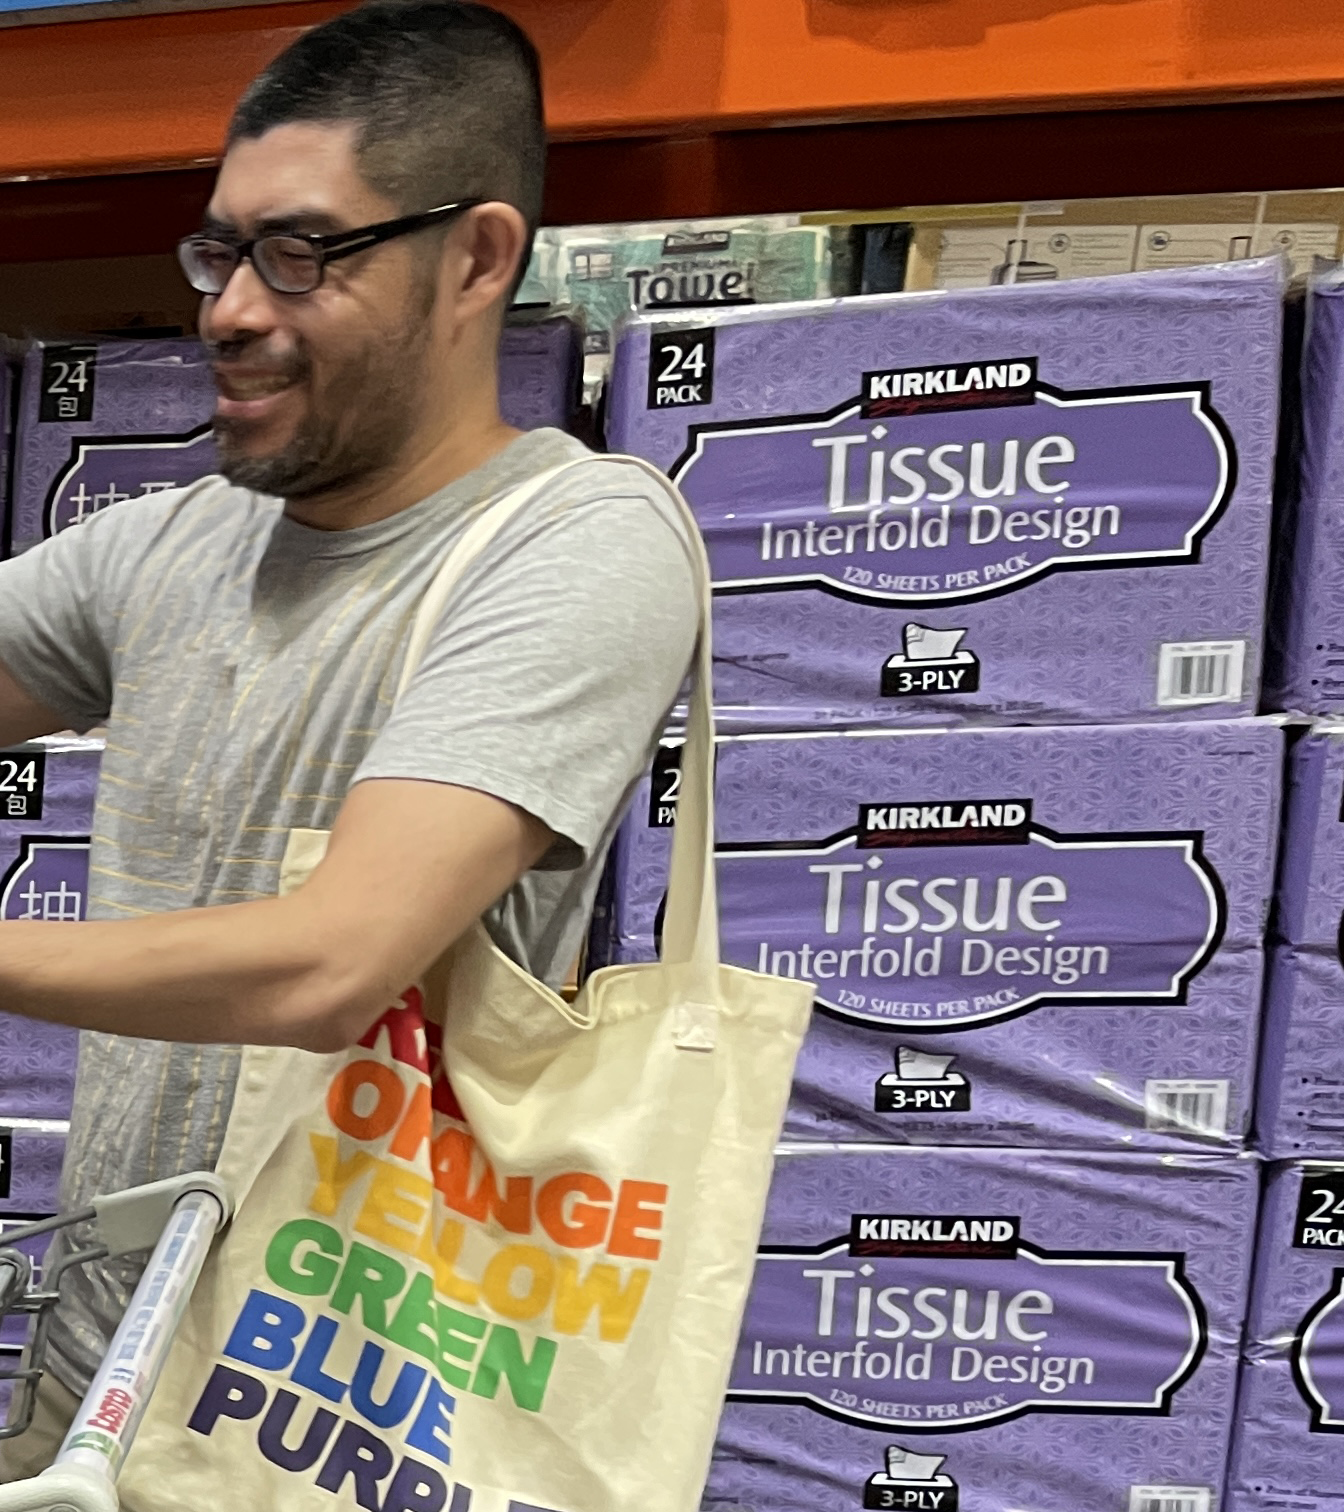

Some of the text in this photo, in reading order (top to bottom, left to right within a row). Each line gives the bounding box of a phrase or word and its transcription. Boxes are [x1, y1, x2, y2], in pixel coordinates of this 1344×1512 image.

[47, 360, 89, 394] 24
[657, 342, 706, 382] 24
[656, 384, 703, 405] PACK
[869, 363, 1031, 400] KIRKLAND
[58, 397, 78, 417] 包
[812, 425, 1075, 512] Tissue
[762, 496, 1119, 561] Interfold Design
[843, 553, 1031, 591] 120 SHEETS PER PACK
[898, 669, 966, 692] 3-PLY
[660, 768, 680, 801] 2
[6, 795, 28, 816] 包
[867, 804, 1026, 831] KIRKLAND
[809, 855, 1067, 934] Tissue
[758, 935, 1109, 985] Interfold Design
[838, 986, 1022, 1018] 120 SHEETS PER PACK
[891, 1090, 955, 1108] 3-PLY
[859, 1218, 1014, 1243] KIRKLAND
[265, 1219, 556, 1412] GREEN
[802, 1264, 1054, 1342] Tissue
[222, 1289, 456, 1466] BLUE
[752, 1340, 1095, 1394] Interfold Design
[829, 1389, 1009, 1419] 120 SHEETS PER PACK
[880, 1490, 945, 1510] 3-PLY
